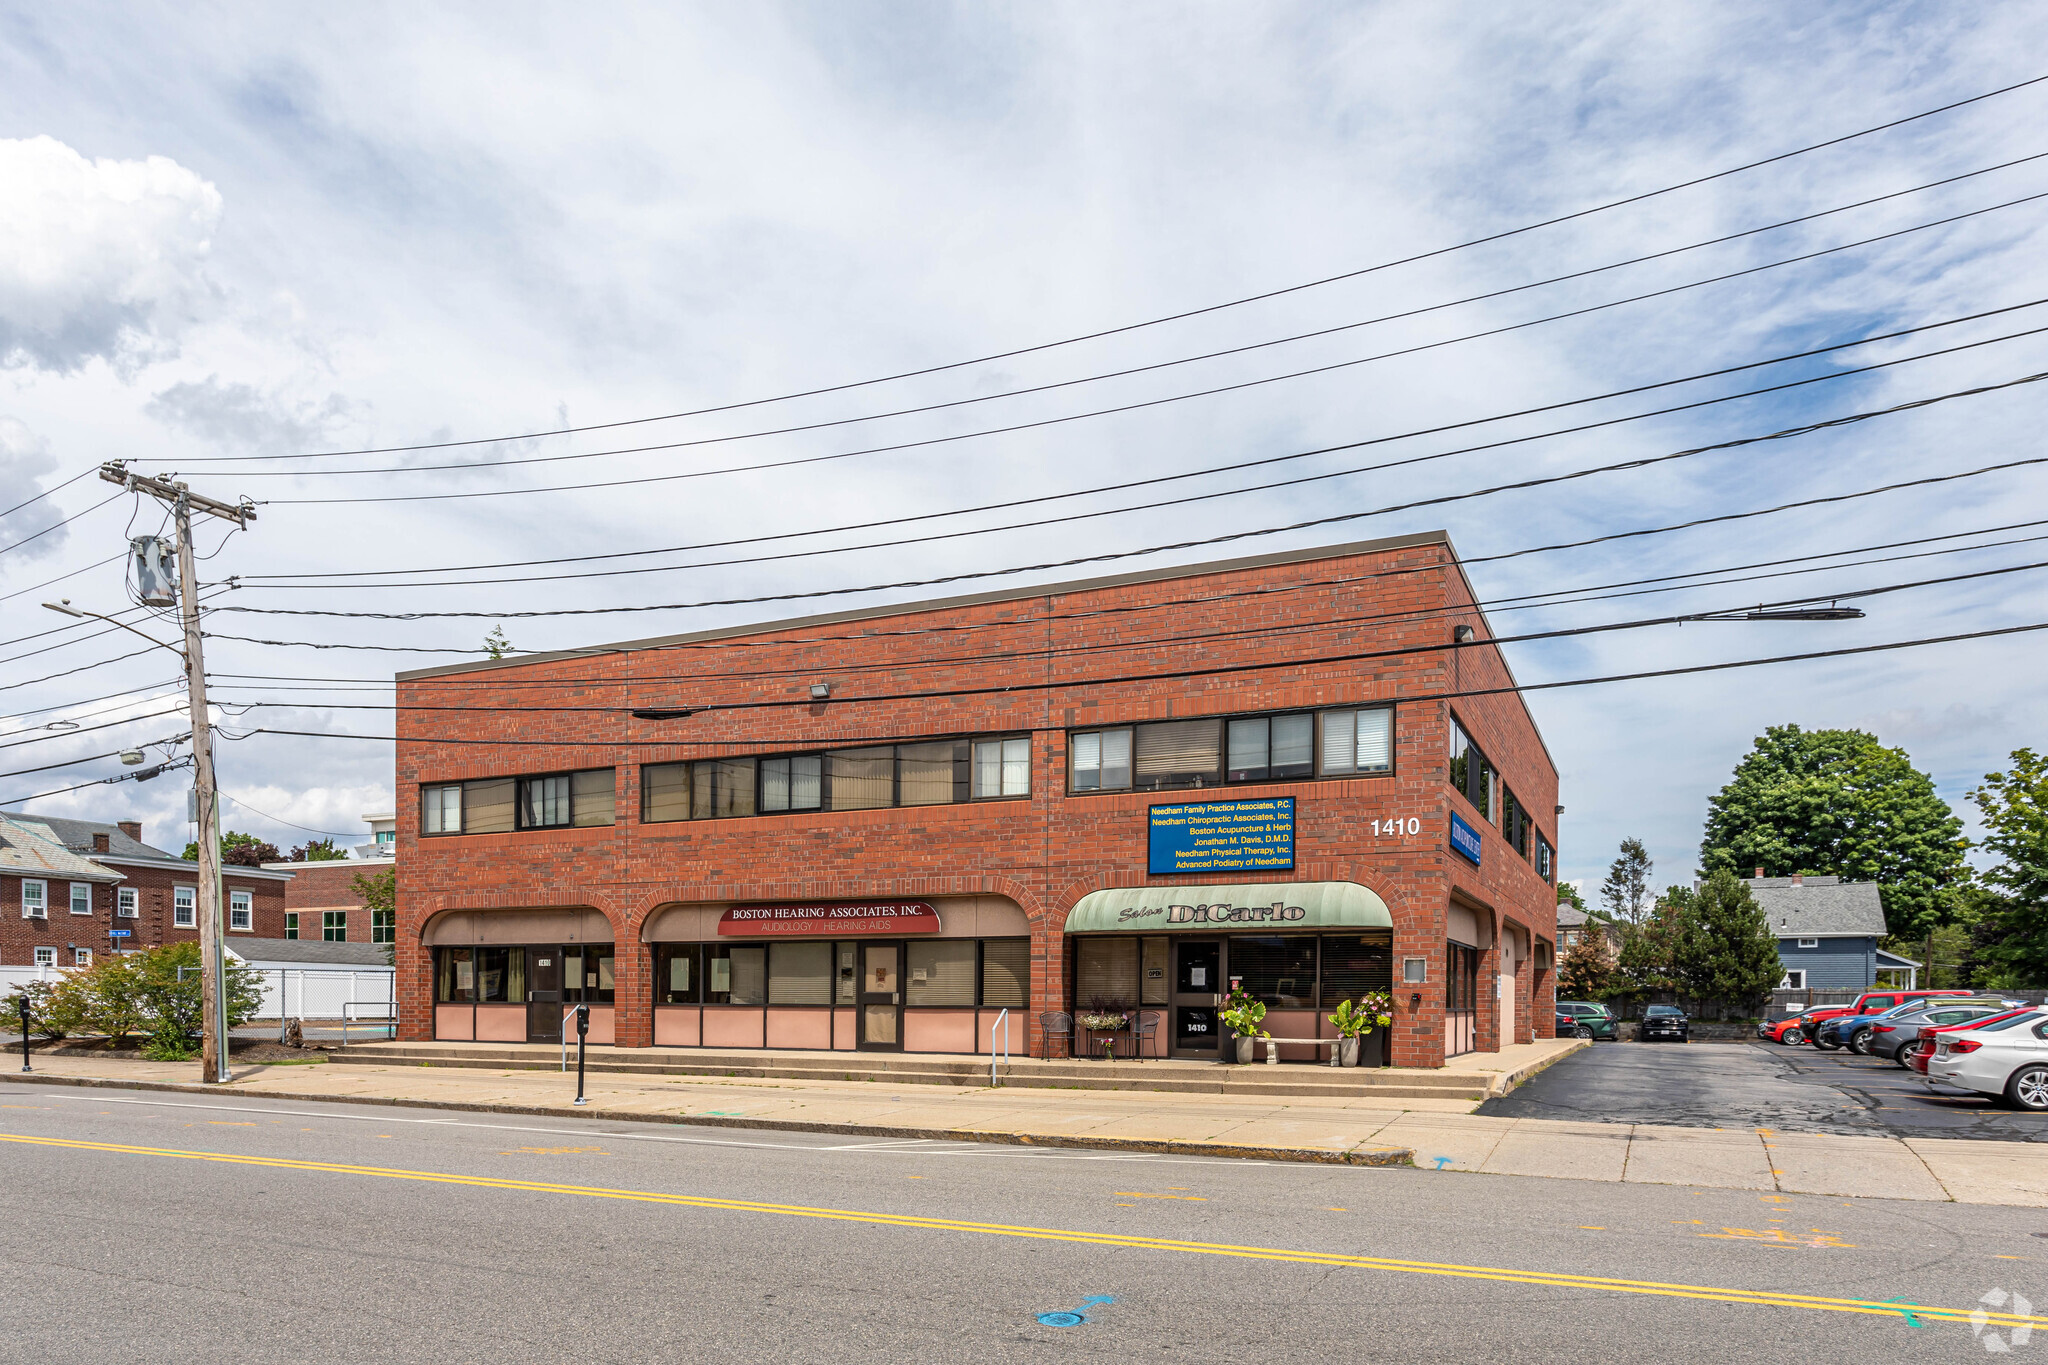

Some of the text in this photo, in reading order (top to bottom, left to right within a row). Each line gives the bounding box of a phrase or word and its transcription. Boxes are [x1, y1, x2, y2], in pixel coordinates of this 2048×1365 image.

[1184, 806, 1206, 814] Family
[1207, 804, 1235, 812] Practice
[1236, 802, 1276, 810] Associates,
[1277, 800, 1290, 808] P.C.
[1187, 814, 1232, 825] Chiropractic
[1233, 813, 1276, 822] Associates,
[1217, 825, 1264, 834] Acupuncture
[1265, 824, 1272, 832] &
[1272, 823, 1292, 831] Herb
[1370, 817, 1420, 837] 1410
[1194, 838, 1228, 846] Jonathan
[1240, 836, 1264, 844] Davis,
[1265, 834, 1291, 843] D.M.D.
[1211, 848, 1242, 858] Physical
[1243, 846, 1276, 856] Therapy,
[1176, 860, 1212, 868] Advanced
[1213, 859, 1244, 868] Podiatry
[1255, 857, 1291, 866] Needham
[733, 905, 922, 919] BOSTON HEARING ASSOCIATES, INC.
[1117, 902, 1306, 924] Salon DiCarlo
[761, 922, 812, 932] AUDIOLOGY
[824, 921, 866, 930] HEARING
[868, 920, 892, 930] AIDS
[1188, 1024, 1208, 1032] 1410
